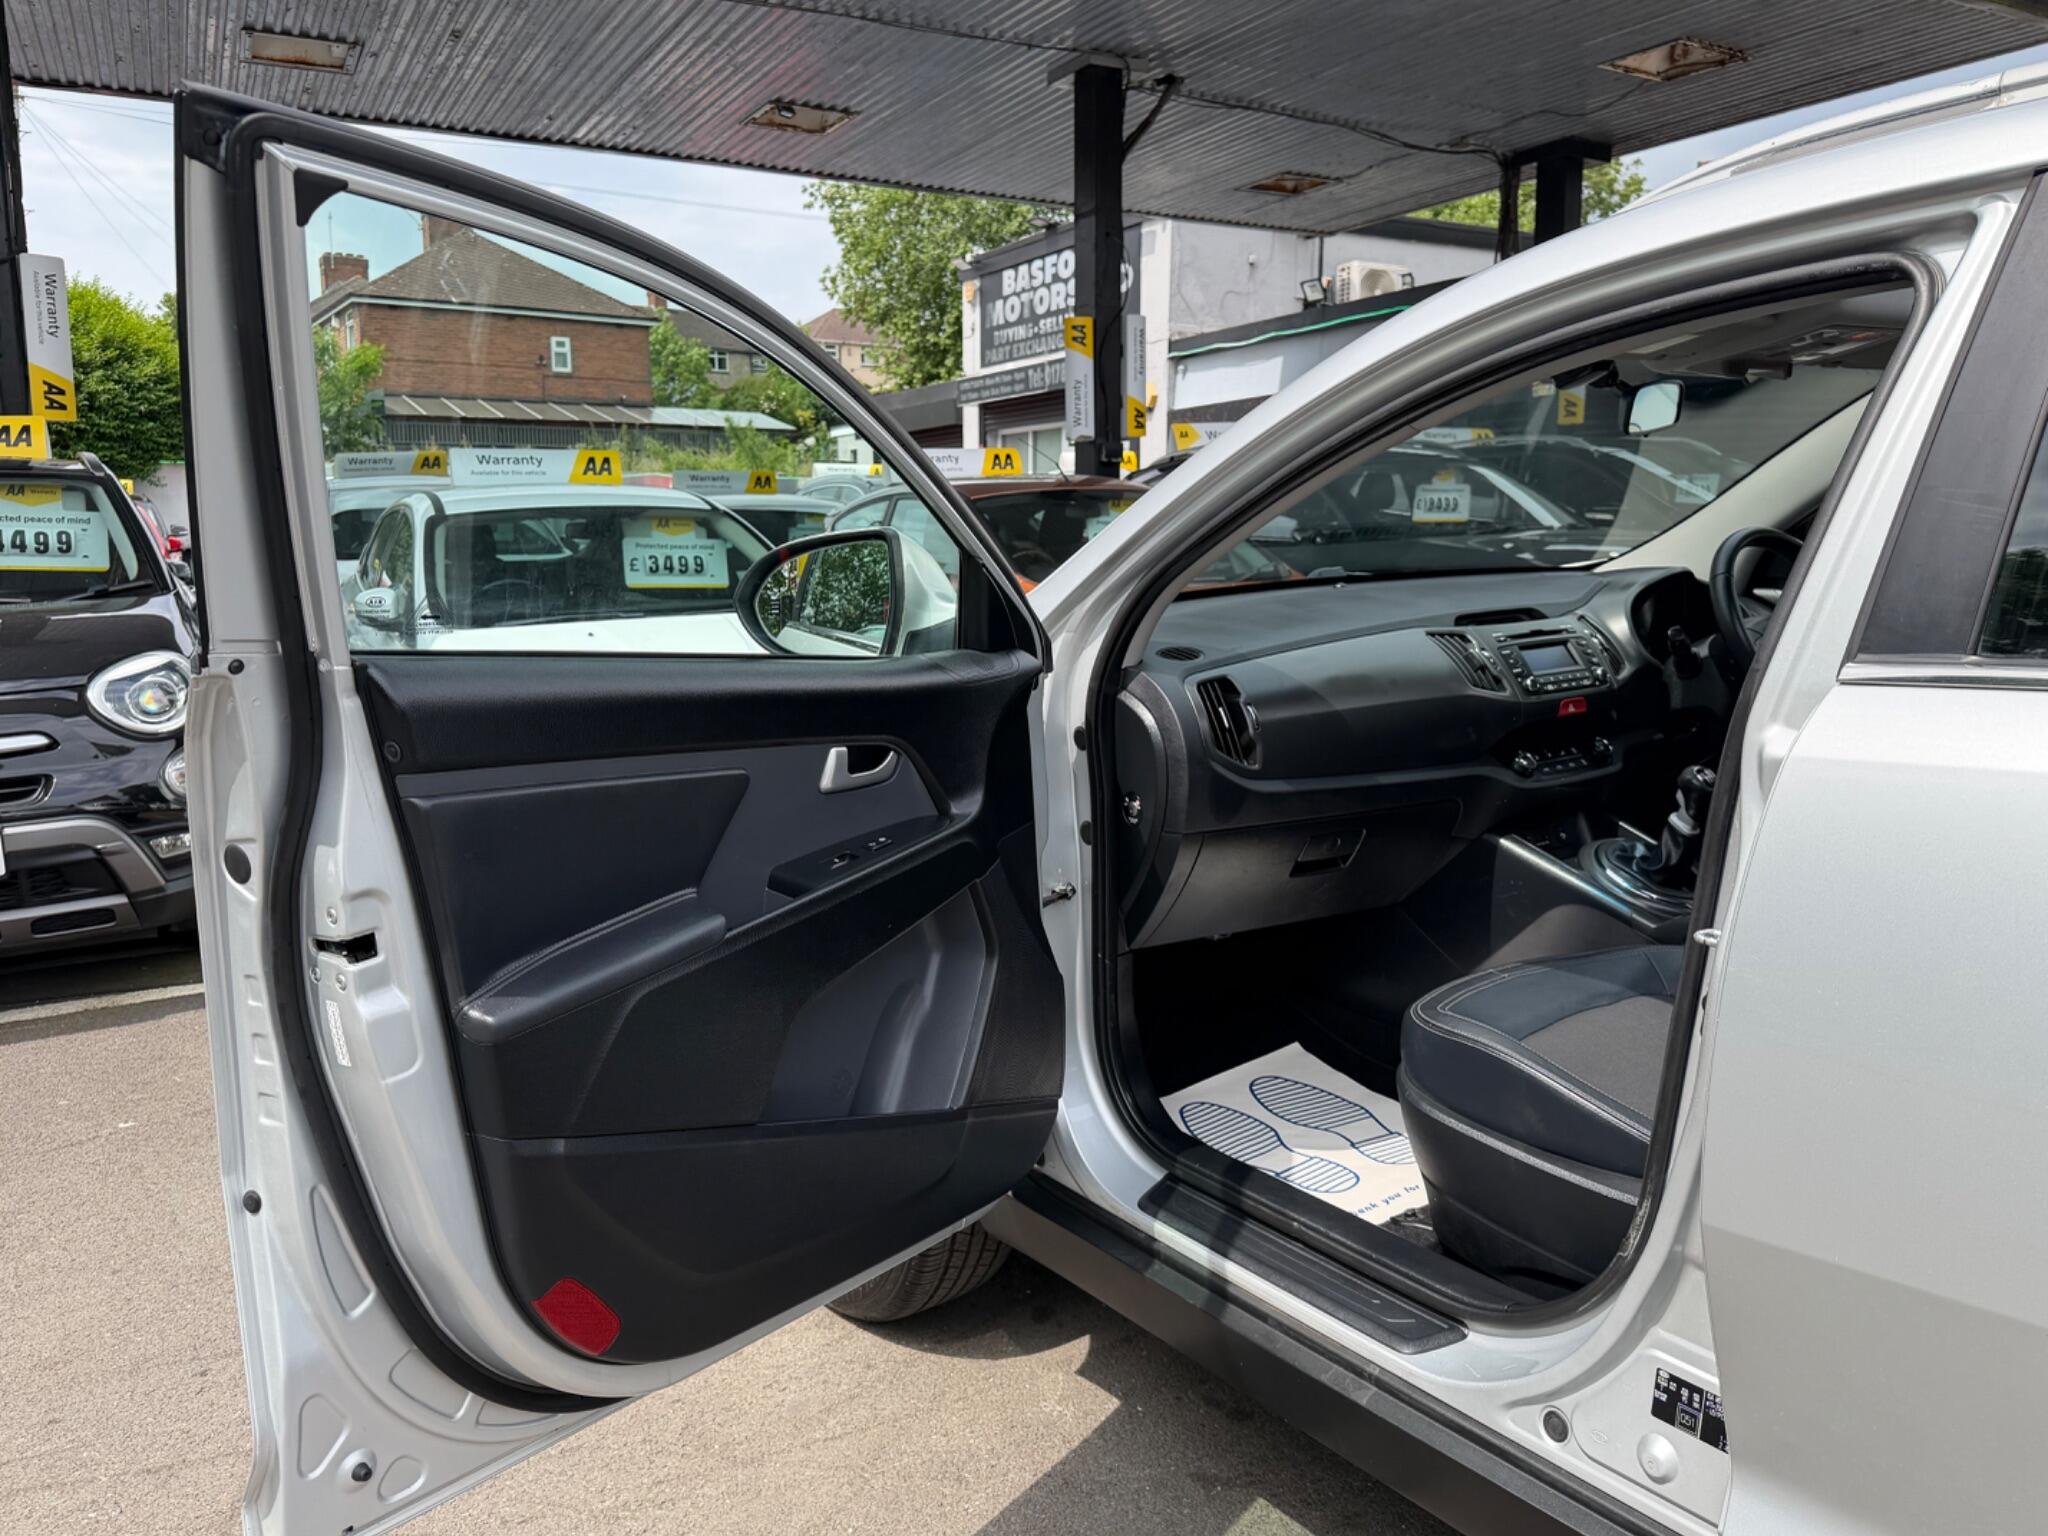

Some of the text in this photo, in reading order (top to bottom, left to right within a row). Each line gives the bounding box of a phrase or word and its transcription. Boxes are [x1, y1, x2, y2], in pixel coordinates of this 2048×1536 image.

[1002, 250, 1076, 297] BASFO
[44, 273, 61, 338] Warranty
[1012, 332, 1065, 358] EXCHANG
[1071, 324, 1087, 347] AA
[42, 380, 68, 411] AA
[1072, 379, 1083, 428] Warranty
[1134, 407, 1145, 430] AA
[1563, 398, 1578, 418] AA
[0, 425, 32, 447] AA
[347, 456, 441, 469] Warranty AA
[475, 454, 612, 476] Warranty AA
[929, 454, 1014, 470] ranty AA
[5, 484, 25, 496] AA
[689, 474, 772, 488] Warranty AA
[24, 516, 51, 525] peace
[55, 516, 66, 524] of
[67, 516, 91, 525] mind
[0, 529, 73, 554] 499
